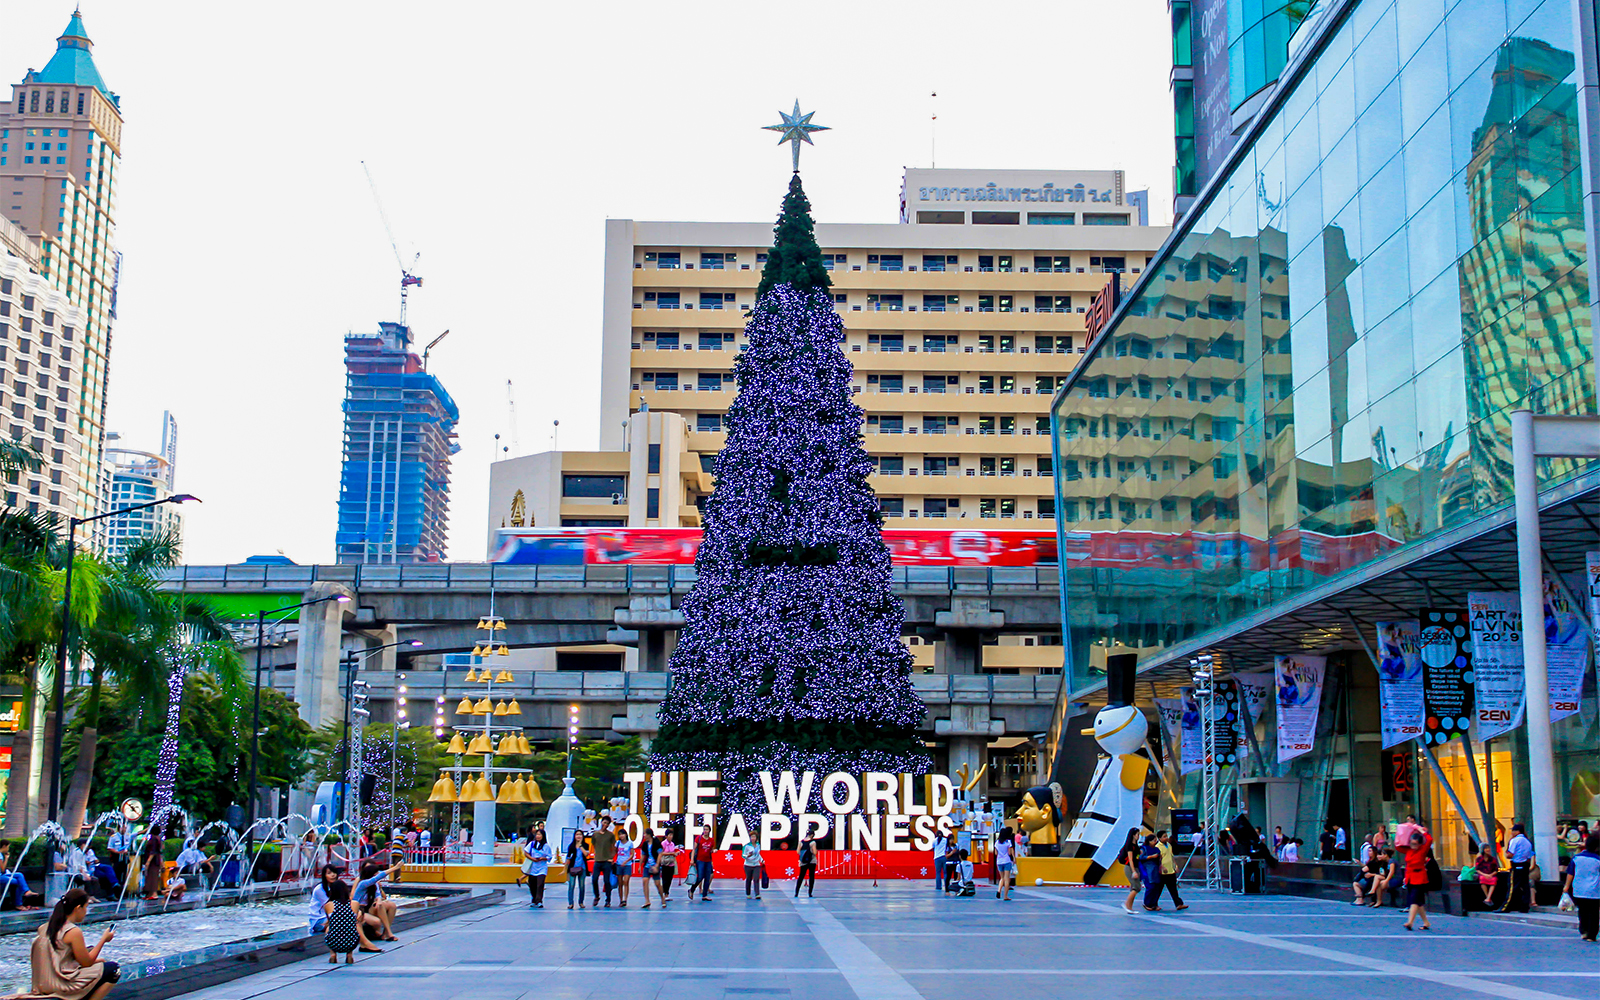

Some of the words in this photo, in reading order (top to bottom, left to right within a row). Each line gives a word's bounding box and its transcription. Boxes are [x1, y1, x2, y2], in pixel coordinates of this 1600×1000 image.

[1475, 611, 1506, 620] ART
[1421, 632, 1452, 640] DESIGN
[1554, 702, 1578, 711] ZEN
[1479, 709, 1511, 721] ZEN
[1401, 726, 1422, 734] ZEN
[623, 771, 720, 814] THE
[759, 771, 954, 816] WORLD
